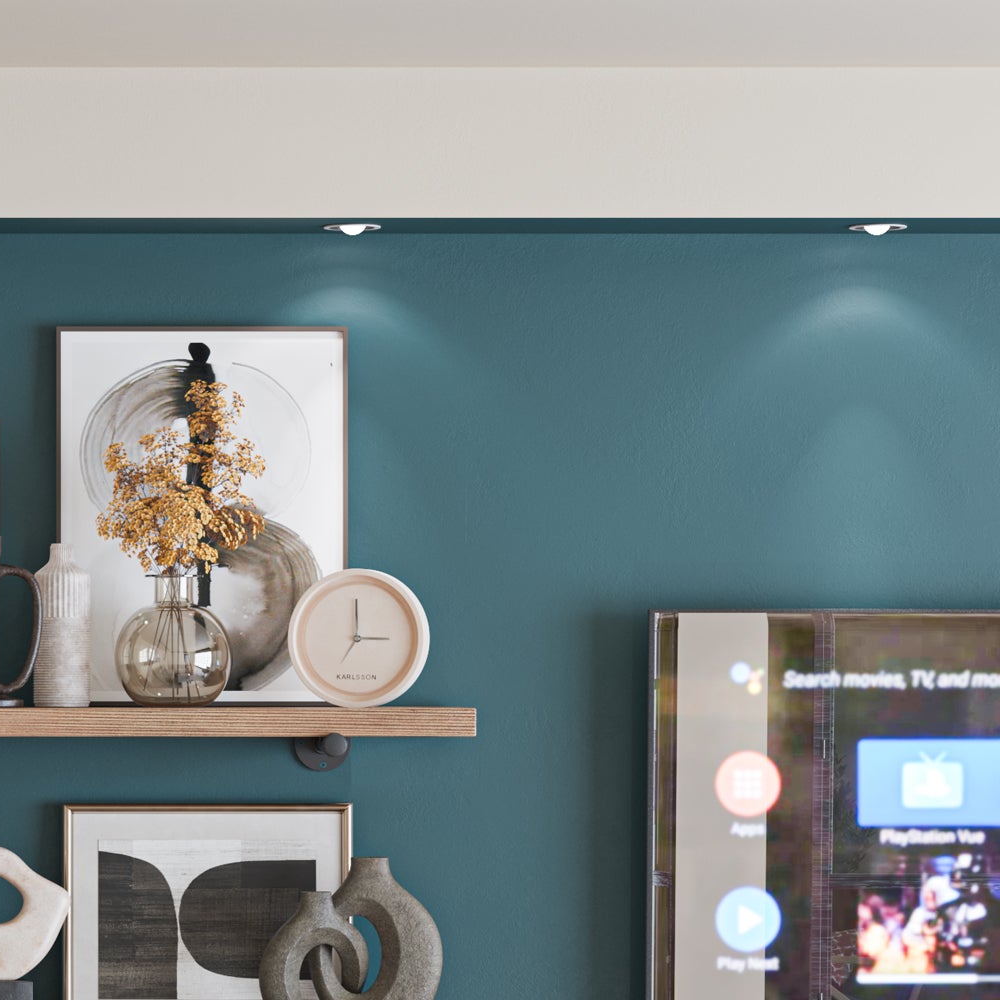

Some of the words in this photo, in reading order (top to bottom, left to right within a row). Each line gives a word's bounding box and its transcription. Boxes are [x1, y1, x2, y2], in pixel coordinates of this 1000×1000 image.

[784, 670, 841, 689] Search
[843, 670, 906, 689] movies,
[910, 670, 935, 689] TV,
[937, 670, 970, 688] and
[730, 823, 767, 837] Apps
[879, 830, 955, 846] PlayStation
[957, 830, 985, 843] Vue
[717, 957, 745, 972] Play
[748, 957, 780, 970] Next
